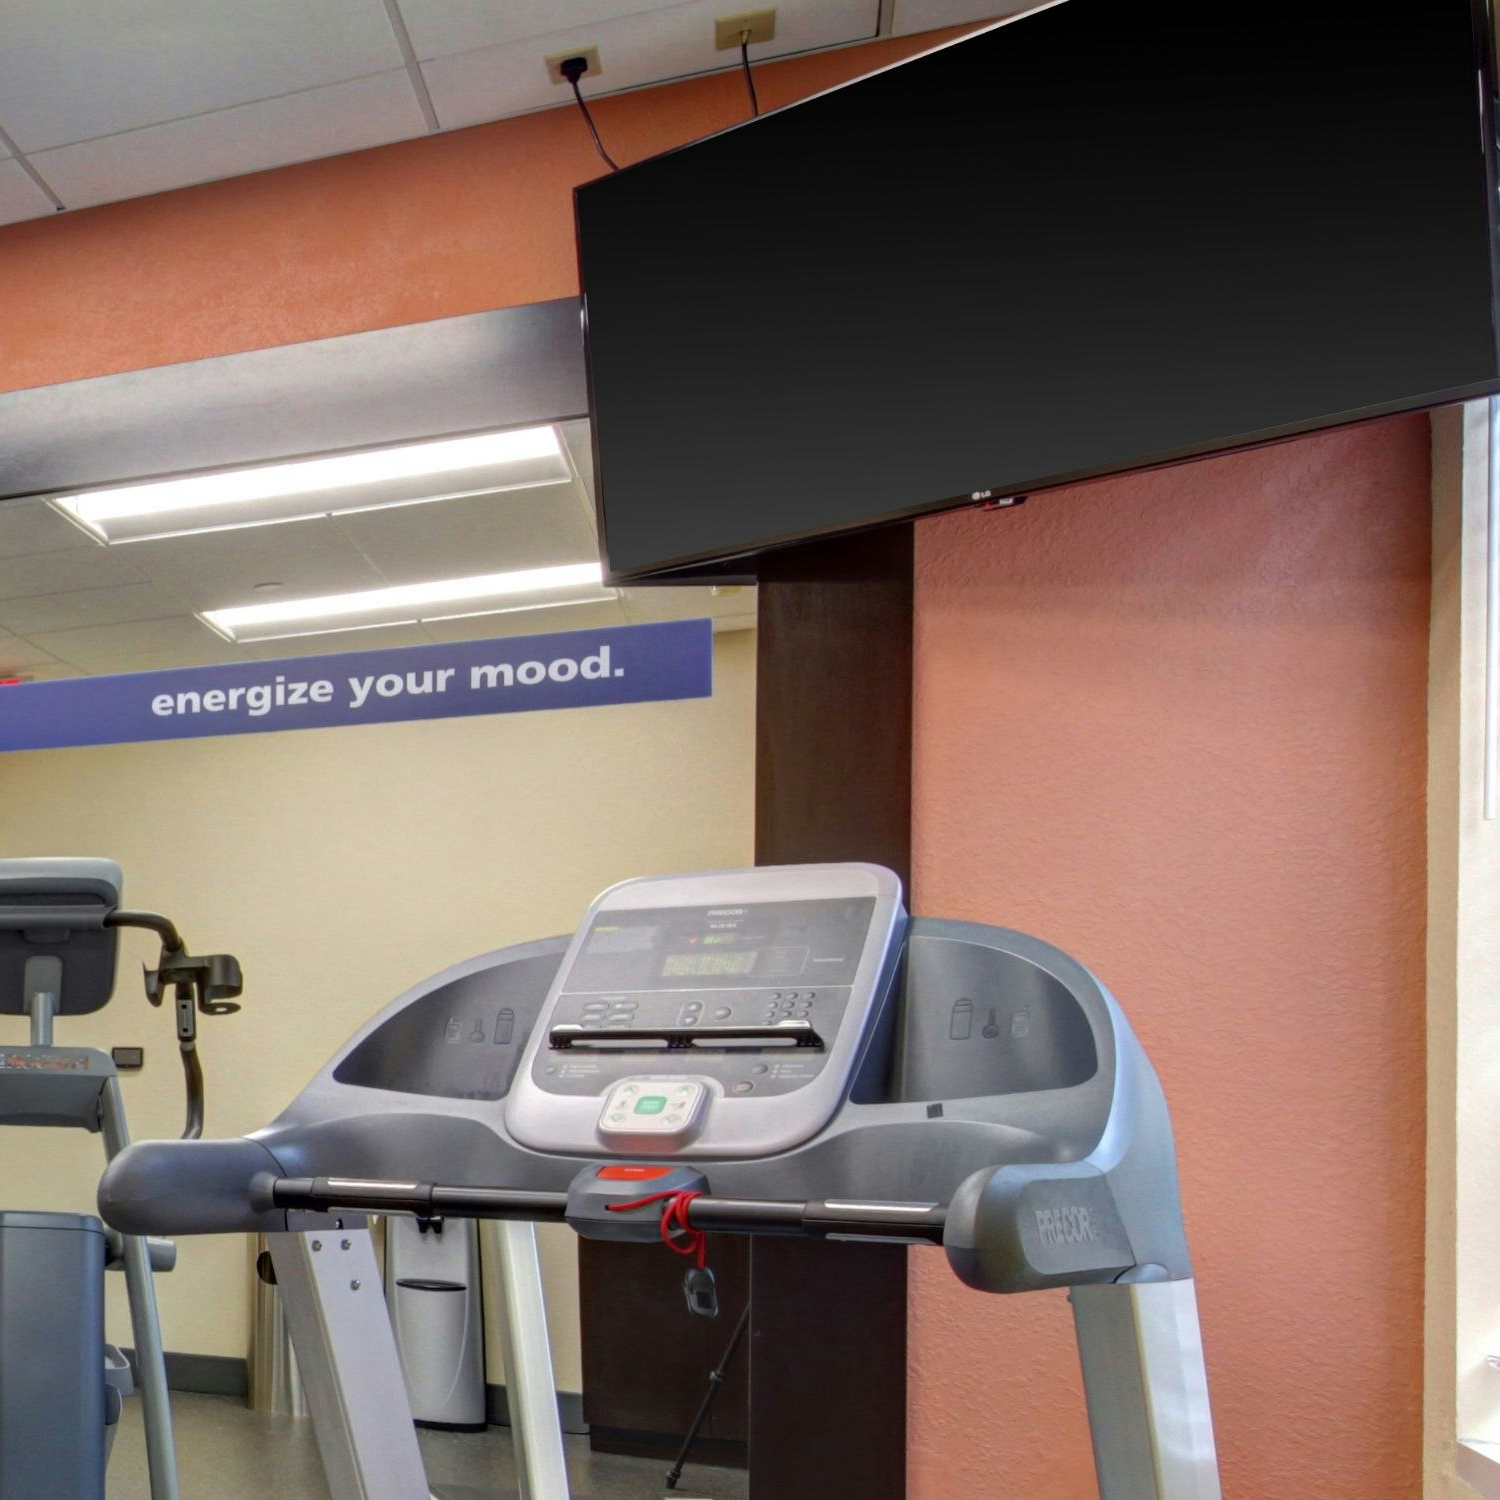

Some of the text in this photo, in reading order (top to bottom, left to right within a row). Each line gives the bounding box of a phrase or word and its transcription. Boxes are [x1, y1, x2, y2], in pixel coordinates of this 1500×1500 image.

[151, 646, 625, 716] energize your mood.
[1035, 1206, 1094, 1246] PRECOR
